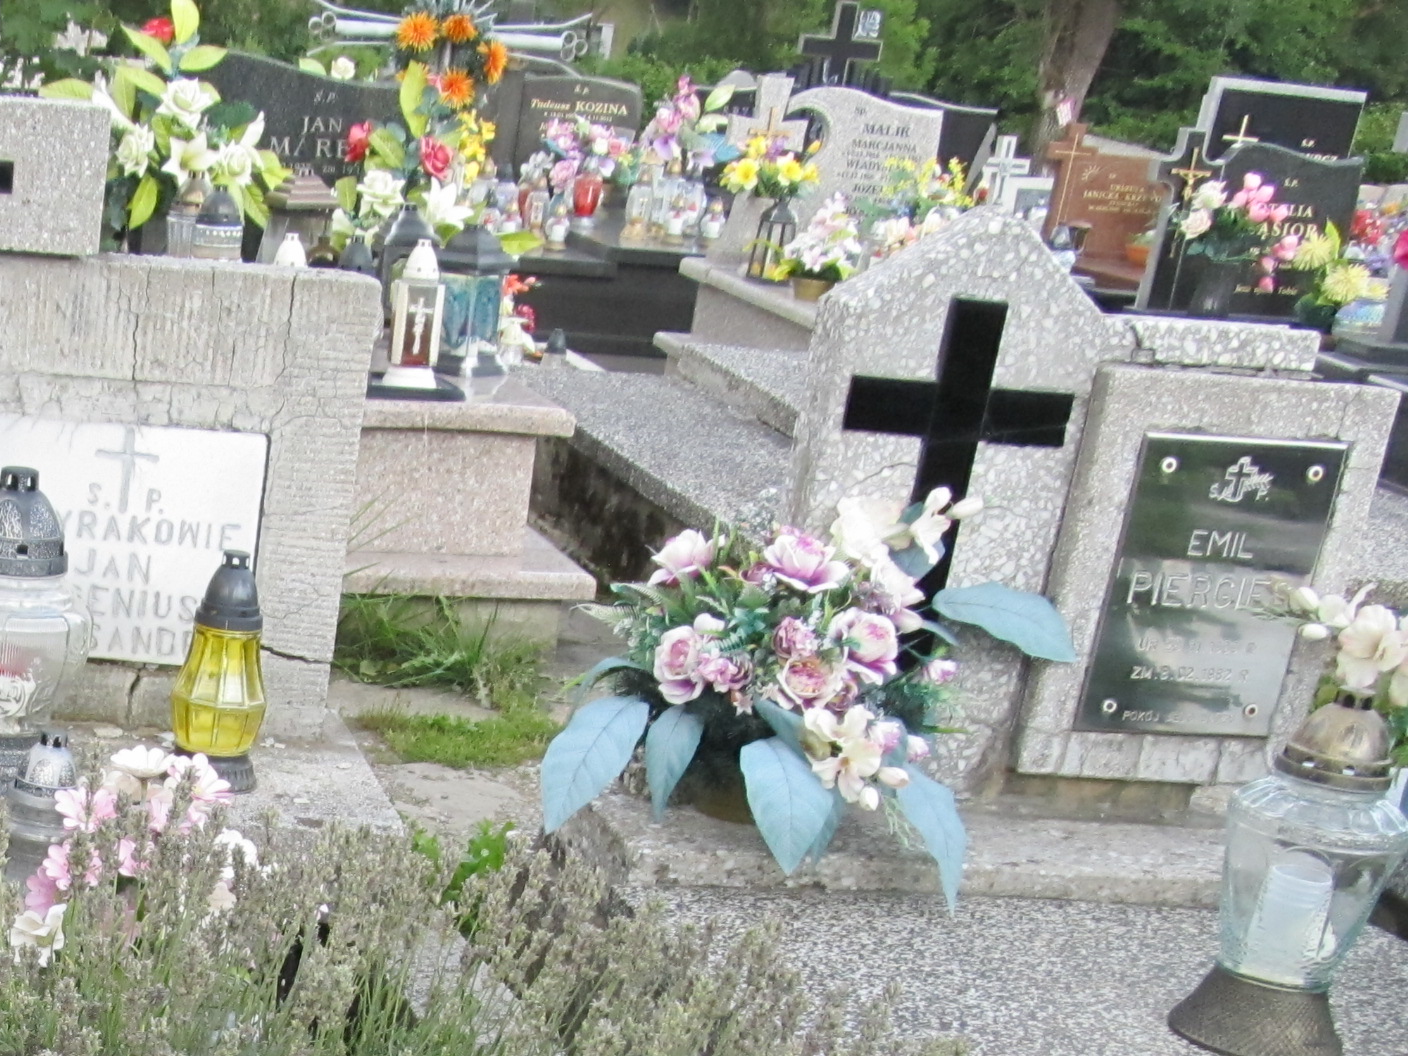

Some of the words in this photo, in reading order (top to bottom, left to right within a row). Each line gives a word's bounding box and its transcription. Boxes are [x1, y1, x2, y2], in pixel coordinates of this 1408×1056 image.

[575, 100, 629, 116] KOZINA
[302, 115, 344, 135] JAN
[862, 123, 911, 138] MALIK
[1186, 528, 1255, 560] EMIL
[73, 548, 152, 585] JAN
[1125, 570, 1272, 612] PIERGIE
